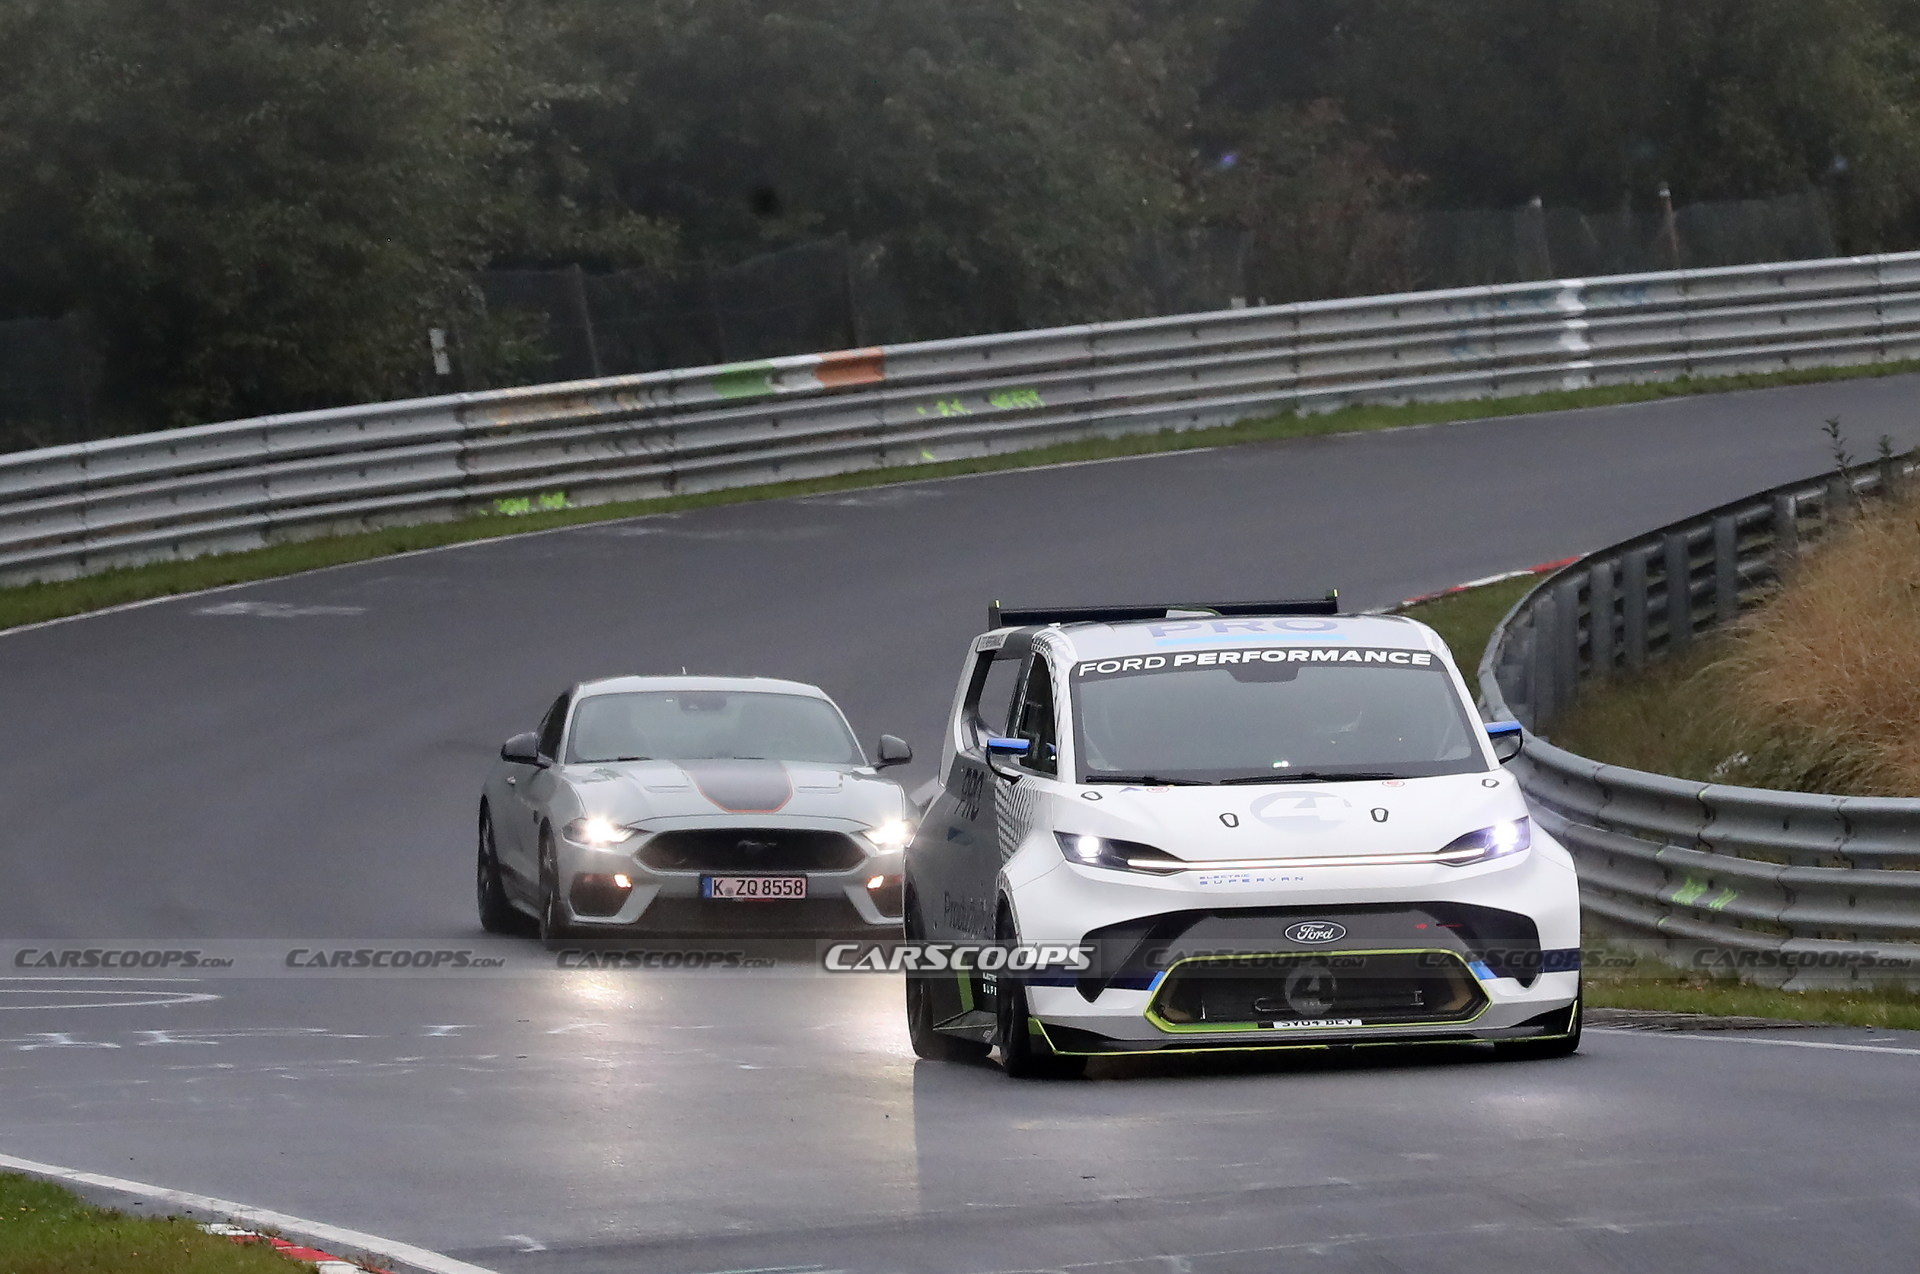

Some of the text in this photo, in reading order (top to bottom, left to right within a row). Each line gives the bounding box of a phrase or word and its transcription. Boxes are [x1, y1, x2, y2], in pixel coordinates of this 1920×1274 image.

[1148, 618, 1339, 638] PRO
[1077, 649, 1433, 677] FORD PERFORMANCE
[713, 879, 804, 896] K ZQ 8558
[1199, 876, 1304, 885] SUPERVAN
[1296, 924, 1335, 940] Ford
